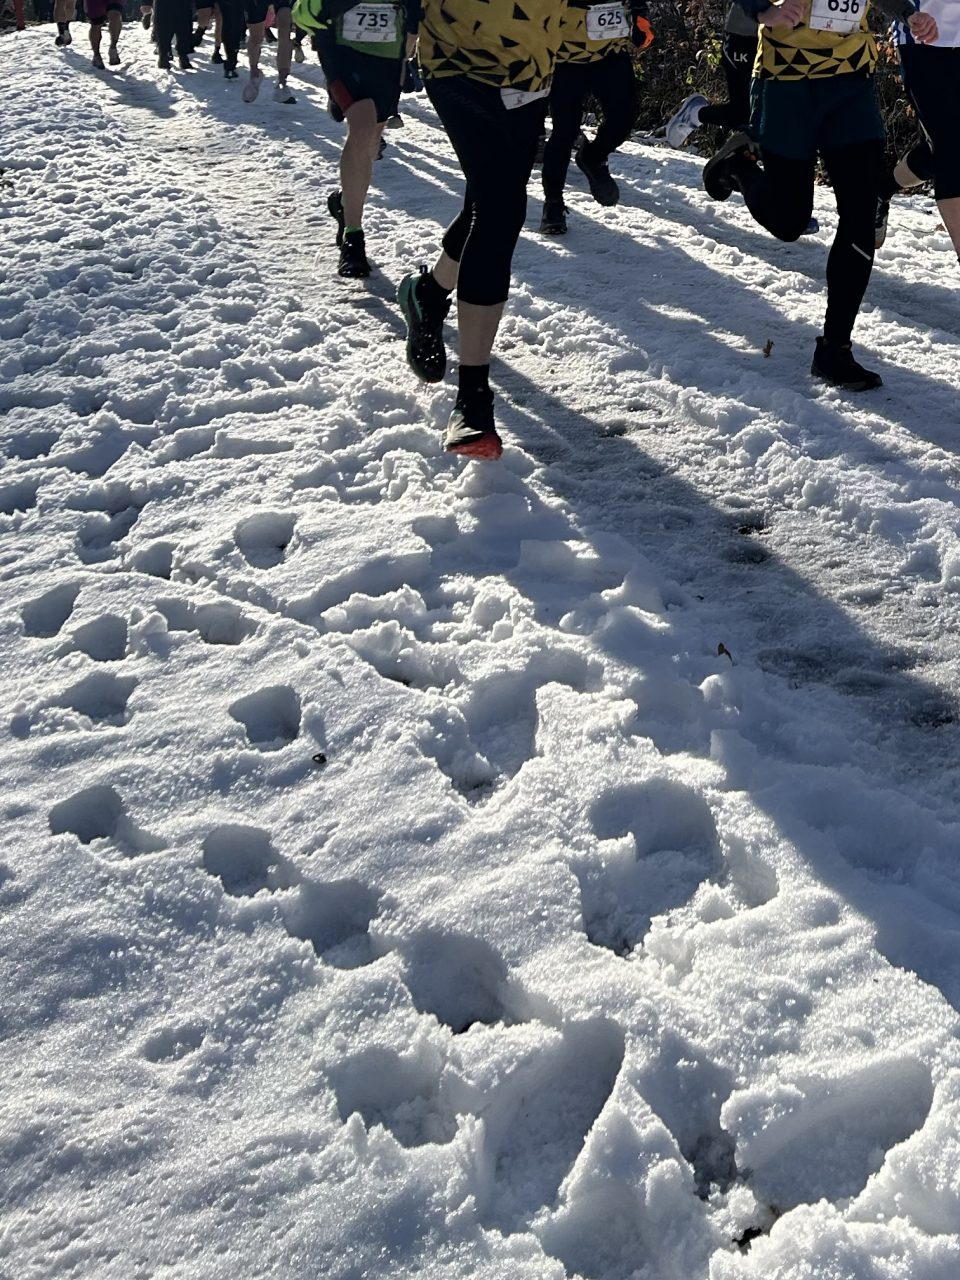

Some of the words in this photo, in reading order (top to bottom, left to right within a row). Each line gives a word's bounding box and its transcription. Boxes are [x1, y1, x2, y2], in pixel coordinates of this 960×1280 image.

[356, 12, 389, 28] 735
[597, 11, 622, 26] 625
[733, 51, 748, 63] LK
